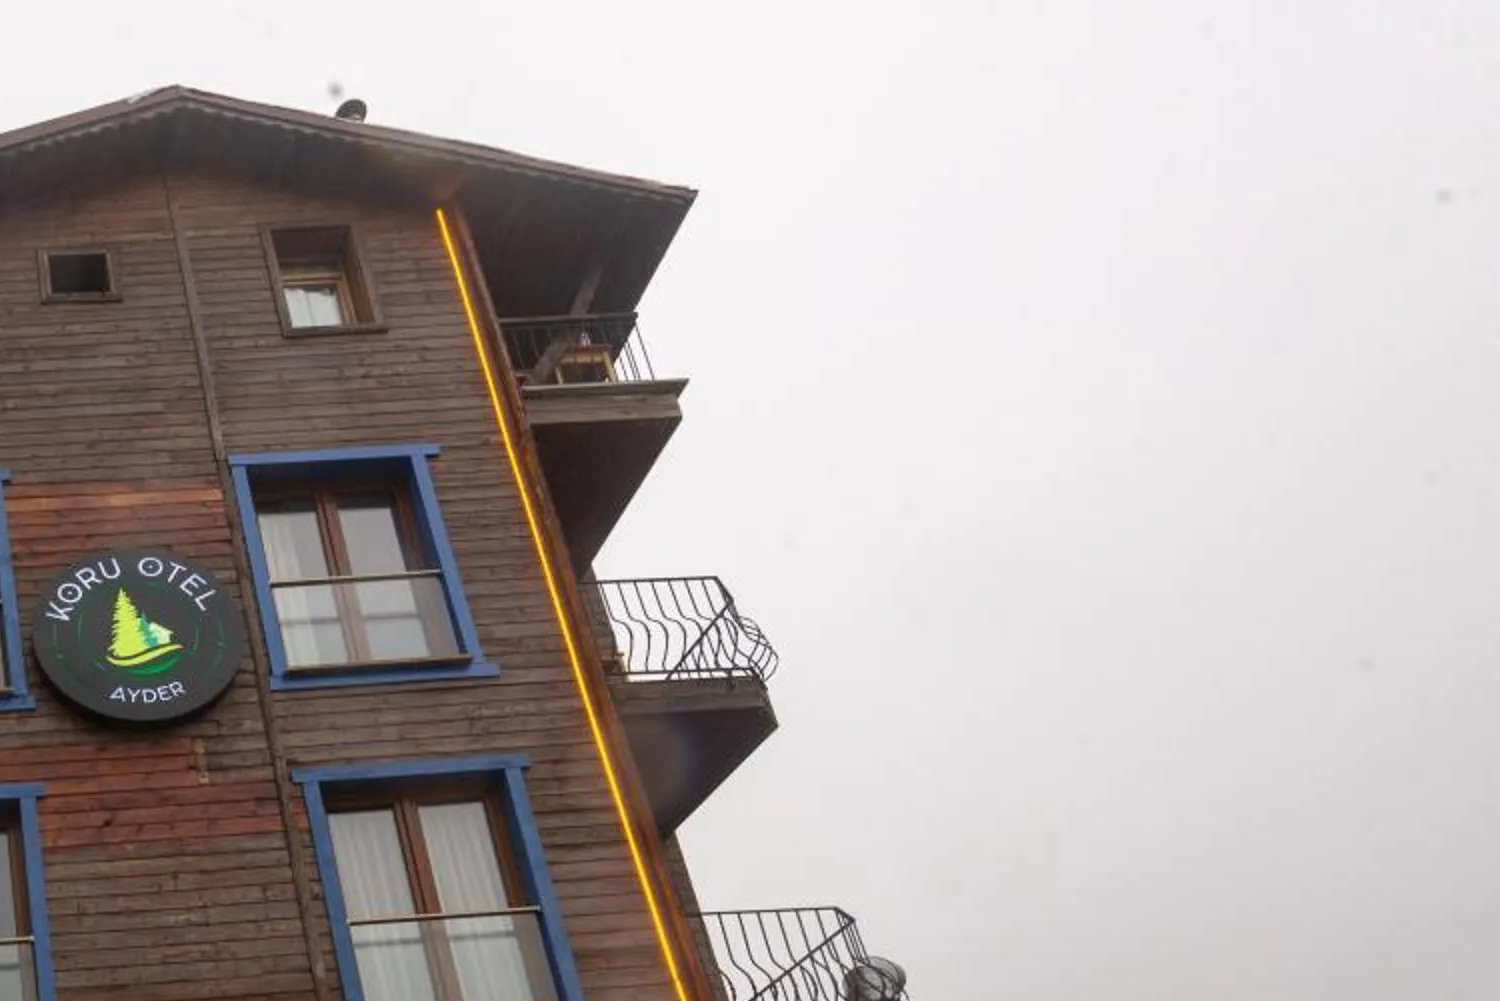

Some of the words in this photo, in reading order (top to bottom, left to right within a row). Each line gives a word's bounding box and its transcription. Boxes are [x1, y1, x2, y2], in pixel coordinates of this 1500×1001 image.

[45, 557, 122, 623] KORU
[137, 556, 217, 612] OTEL
[109, 681, 187, 704] AYDER
